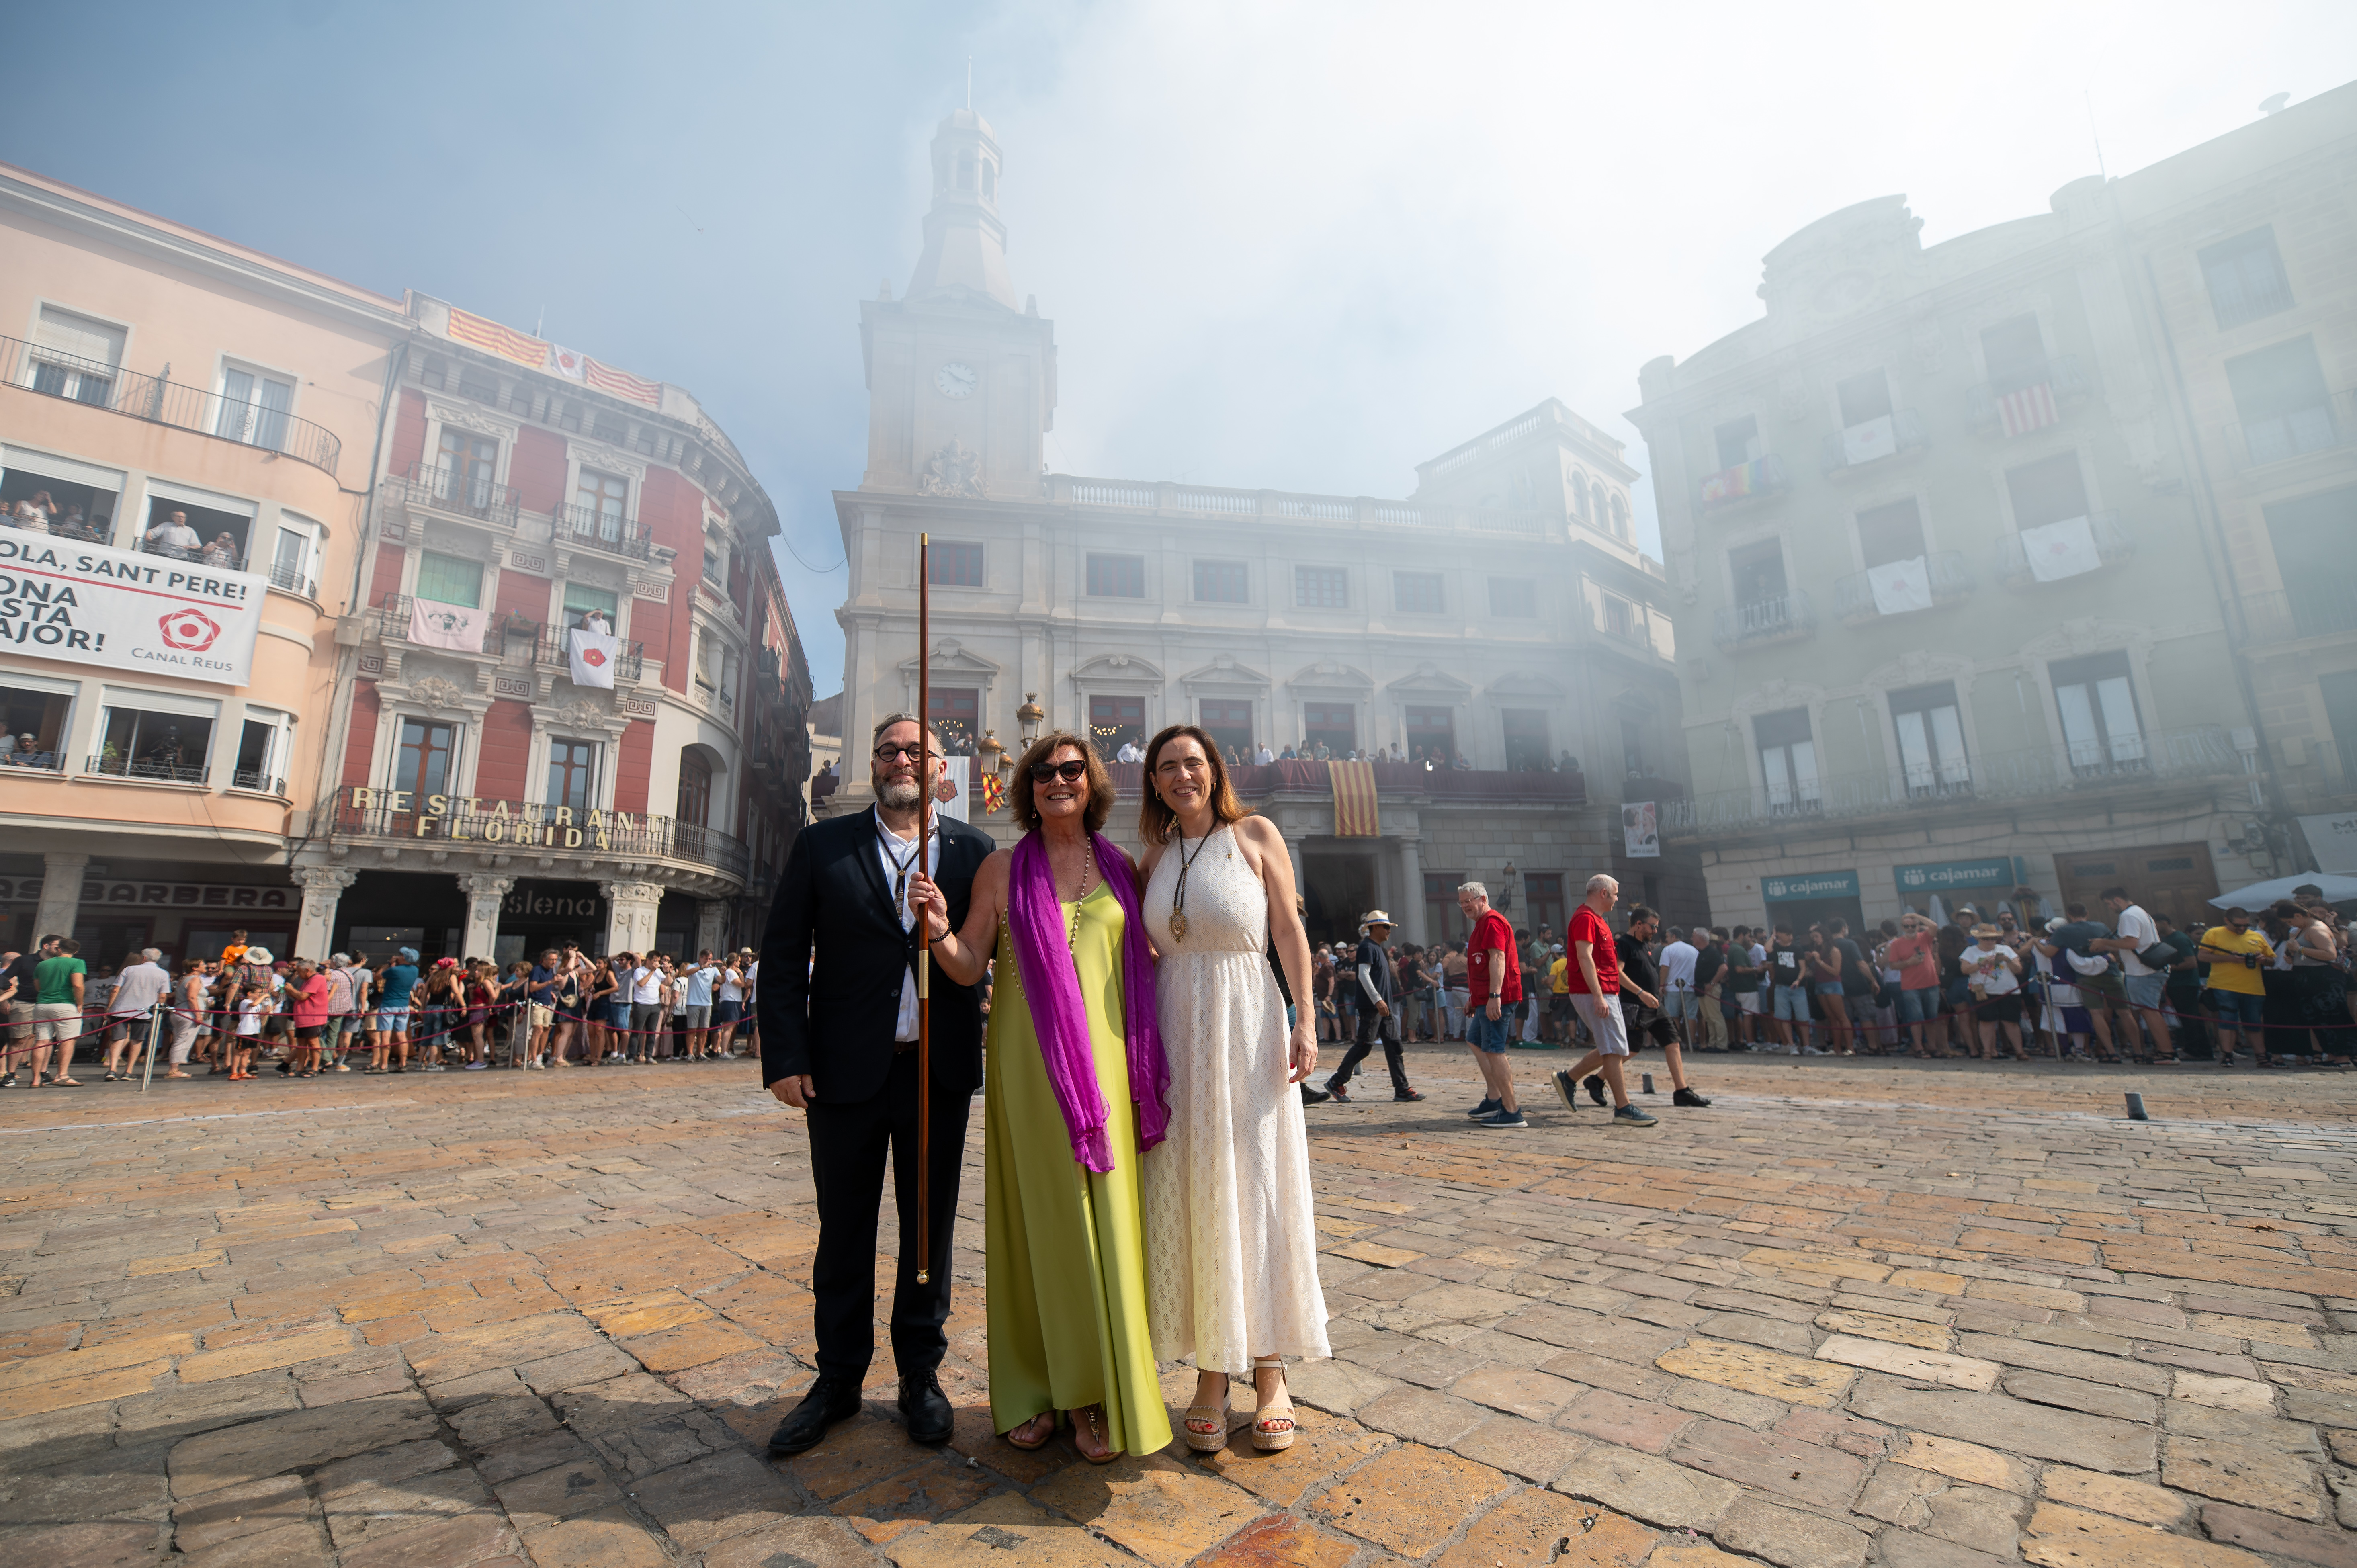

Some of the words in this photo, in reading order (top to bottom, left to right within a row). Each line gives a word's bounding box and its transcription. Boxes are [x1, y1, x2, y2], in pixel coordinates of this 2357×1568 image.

[75, 556, 160, 584] SANT
[167, 572, 247, 600] PERE!
[131, 647, 186, 665] CANAL
[351, 787, 662, 833] RESTAURANT
[416, 815, 610, 850] FLORIDA
[2331, 819, 2357, 829] M
[1789, 878, 1849, 894] cajamar
[1929, 867, 2000, 883] cajamar
[80, 883, 286, 907] BARBERA
[500, 890, 596, 916] slena
